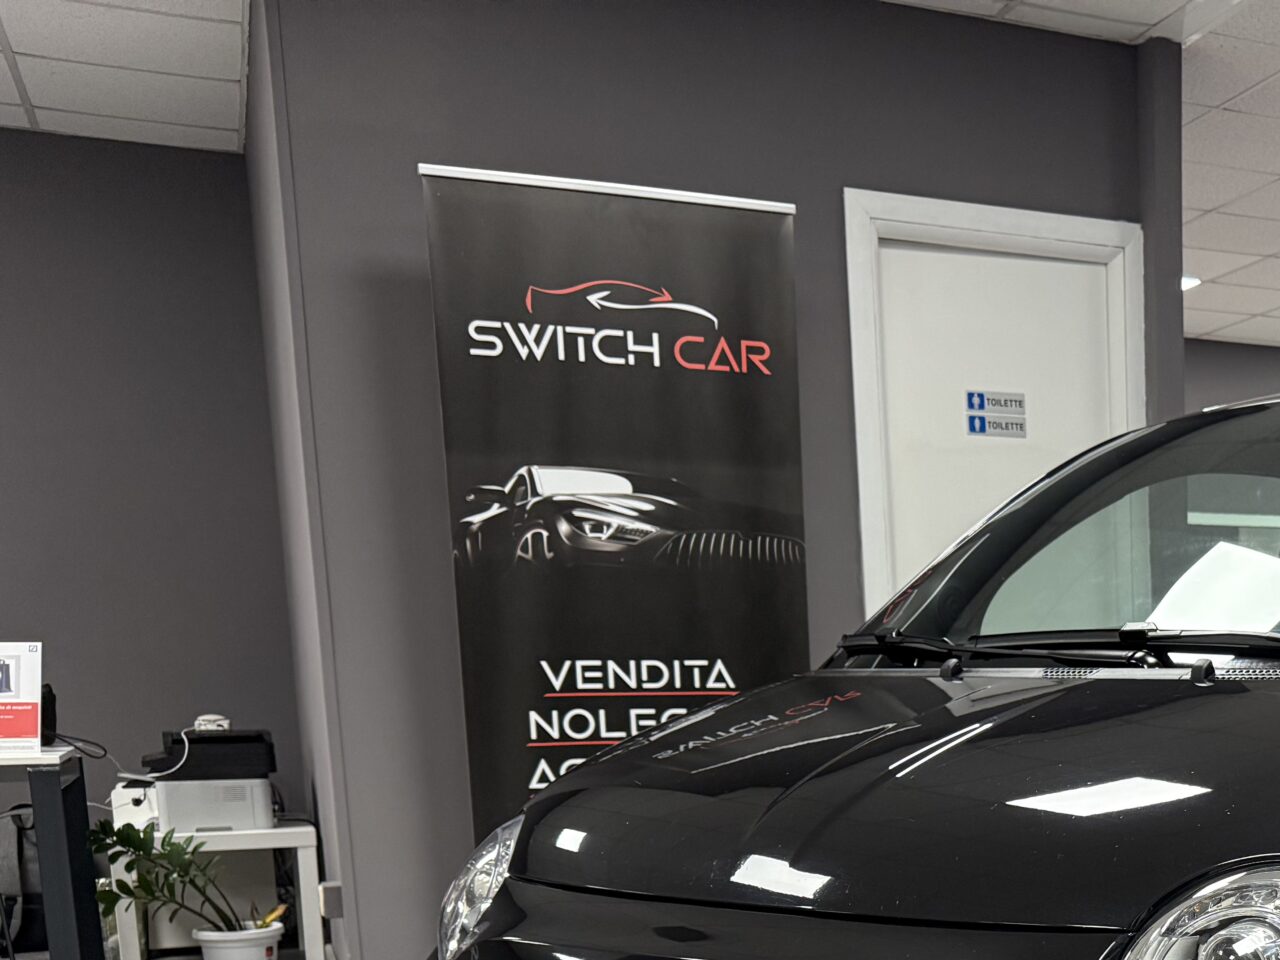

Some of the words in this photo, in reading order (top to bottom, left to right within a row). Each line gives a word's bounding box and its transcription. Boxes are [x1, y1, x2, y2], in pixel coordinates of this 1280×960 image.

[467, 319, 661, 368] SWITCH
[673, 335, 772, 376] CAR
[986, 398, 1024, 408] TOILETTE
[987, 421, 1024, 432] TOILETTE
[539, 658, 736, 692] VENDITA
